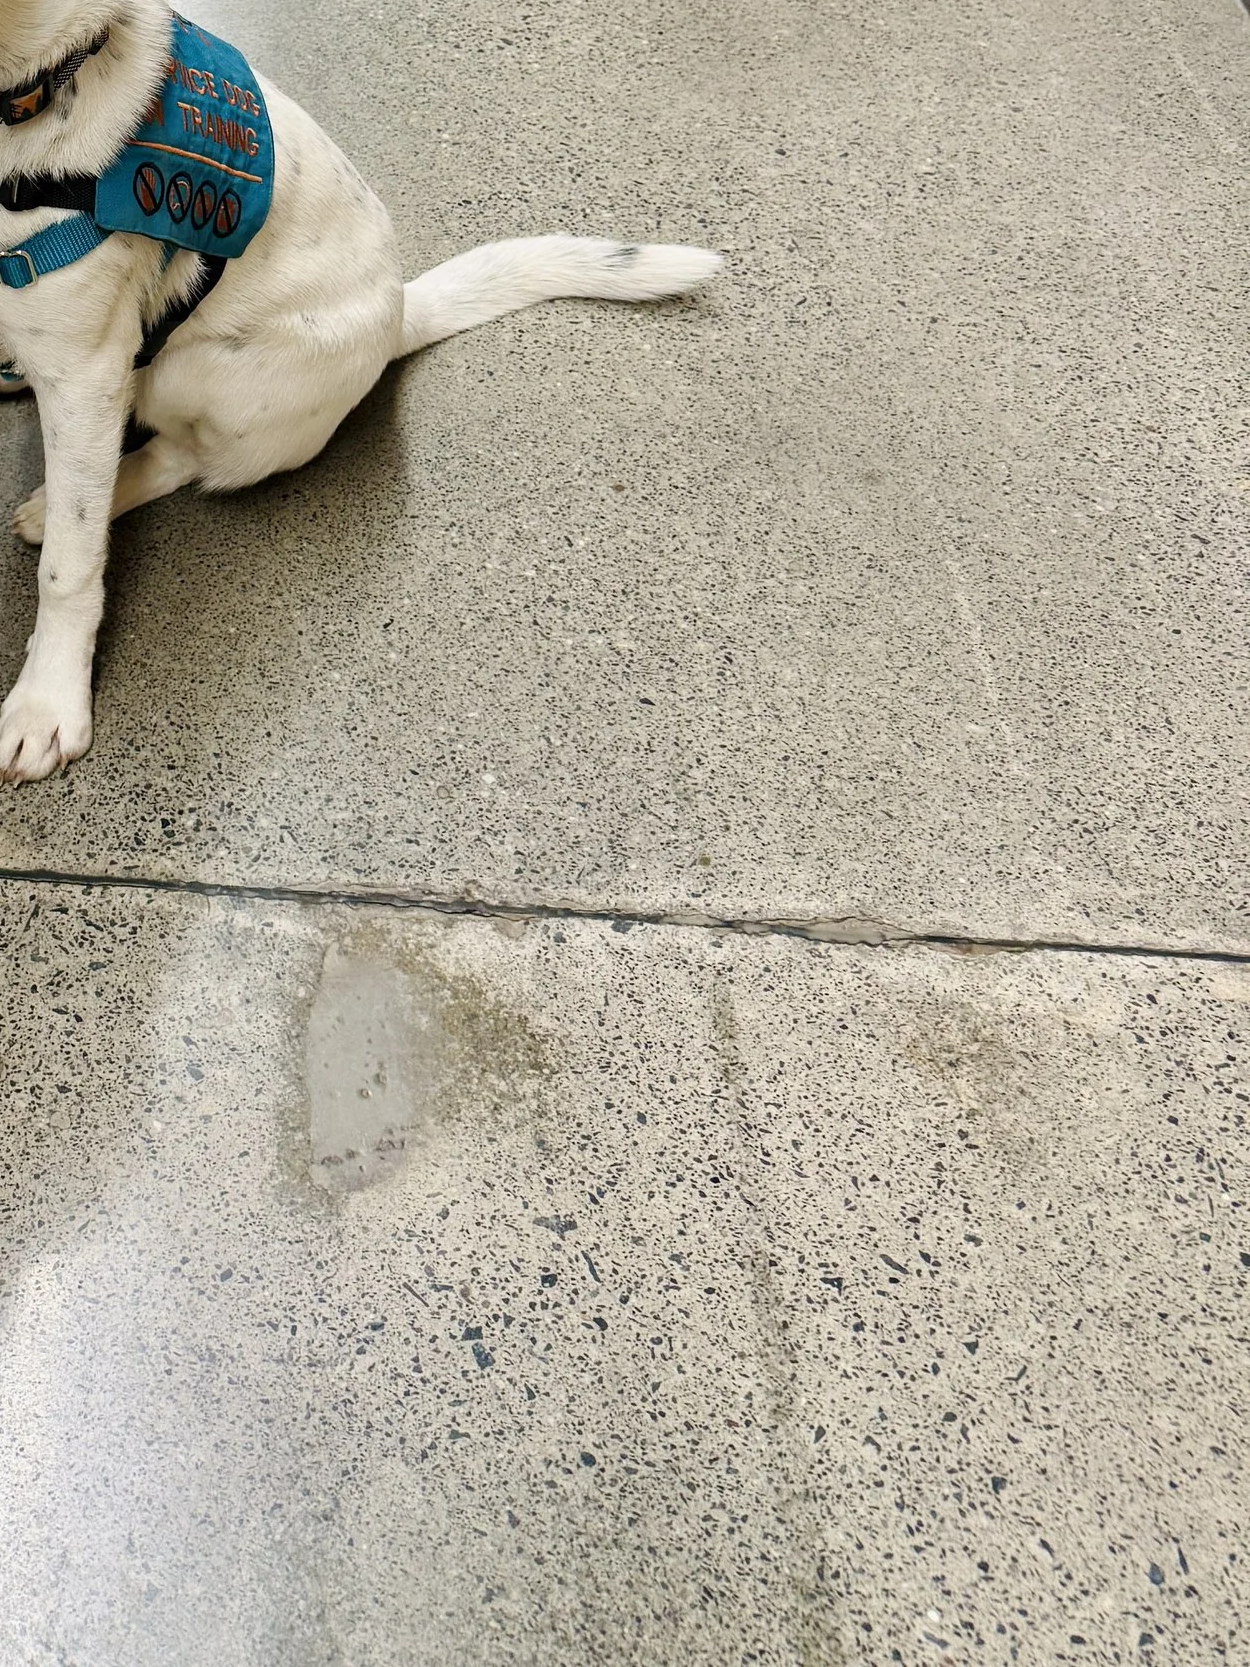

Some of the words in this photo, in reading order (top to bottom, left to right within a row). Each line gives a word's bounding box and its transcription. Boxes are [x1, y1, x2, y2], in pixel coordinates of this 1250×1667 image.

[167, 56, 219, 100] RVICE
[221, 77, 261, 117] DOG
[177, 101, 260, 157] TRAINING
